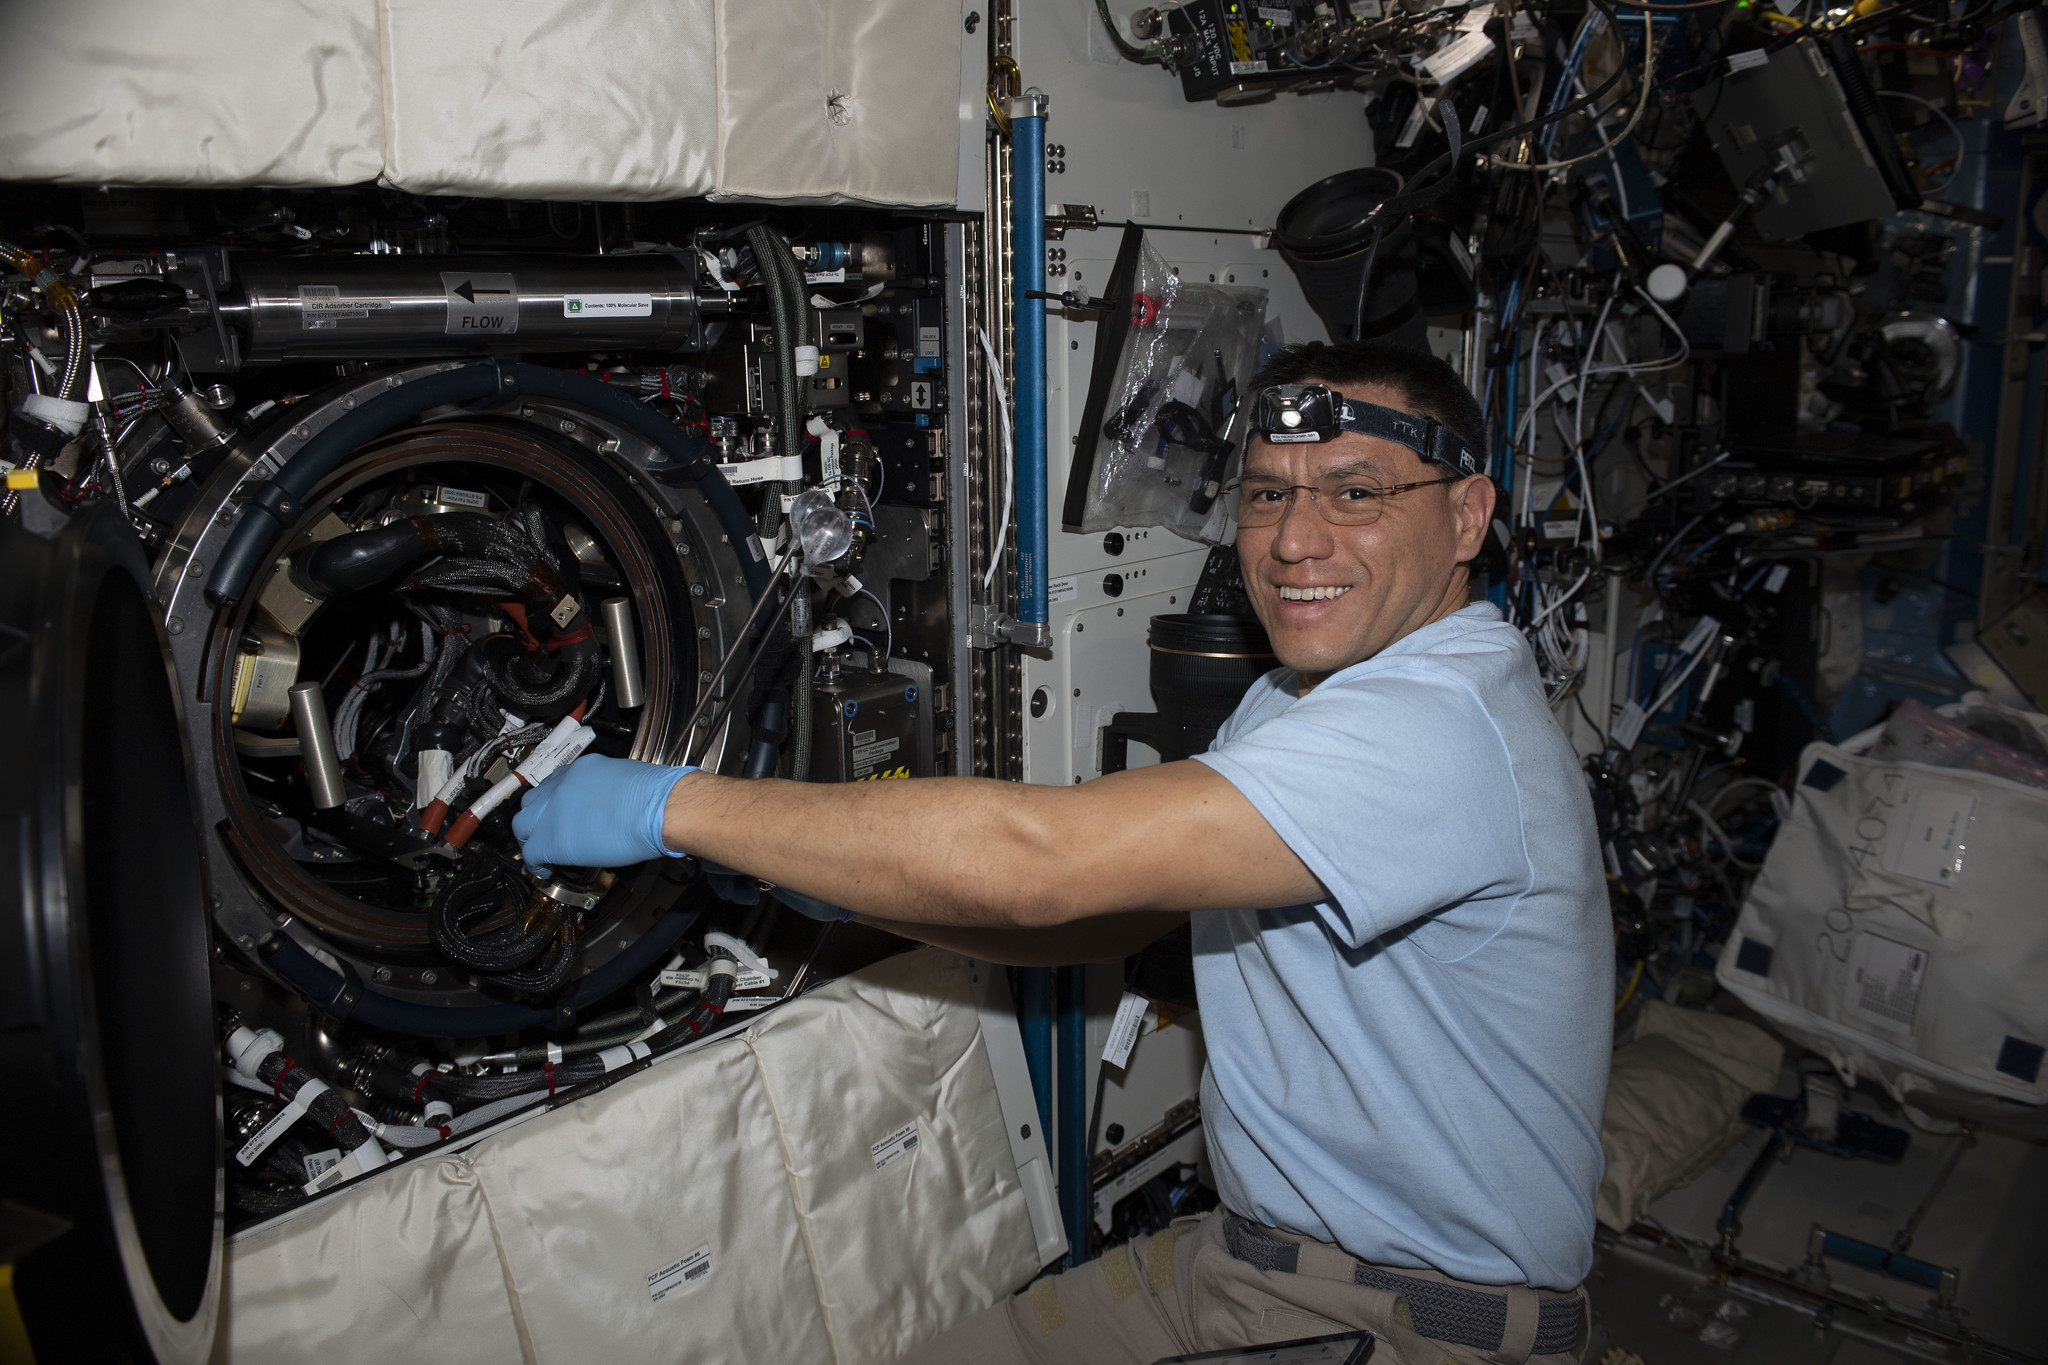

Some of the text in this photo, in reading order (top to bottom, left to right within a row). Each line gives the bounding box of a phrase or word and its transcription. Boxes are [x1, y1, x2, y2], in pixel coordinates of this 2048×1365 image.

[1198, 9, 1206, 26] 12A
[1202, 29, 1212, 46] MAX
[1208, 23, 1222, 60] 120 VDC
[462, 316, 504, 329] FLOW
[880, 1135, 896, 1147] Acoustic
[241, 1146, 249, 1155] P/N
[658, 1262, 681, 1277] Acoustic
[680, 1255, 694, 1265] Foam
